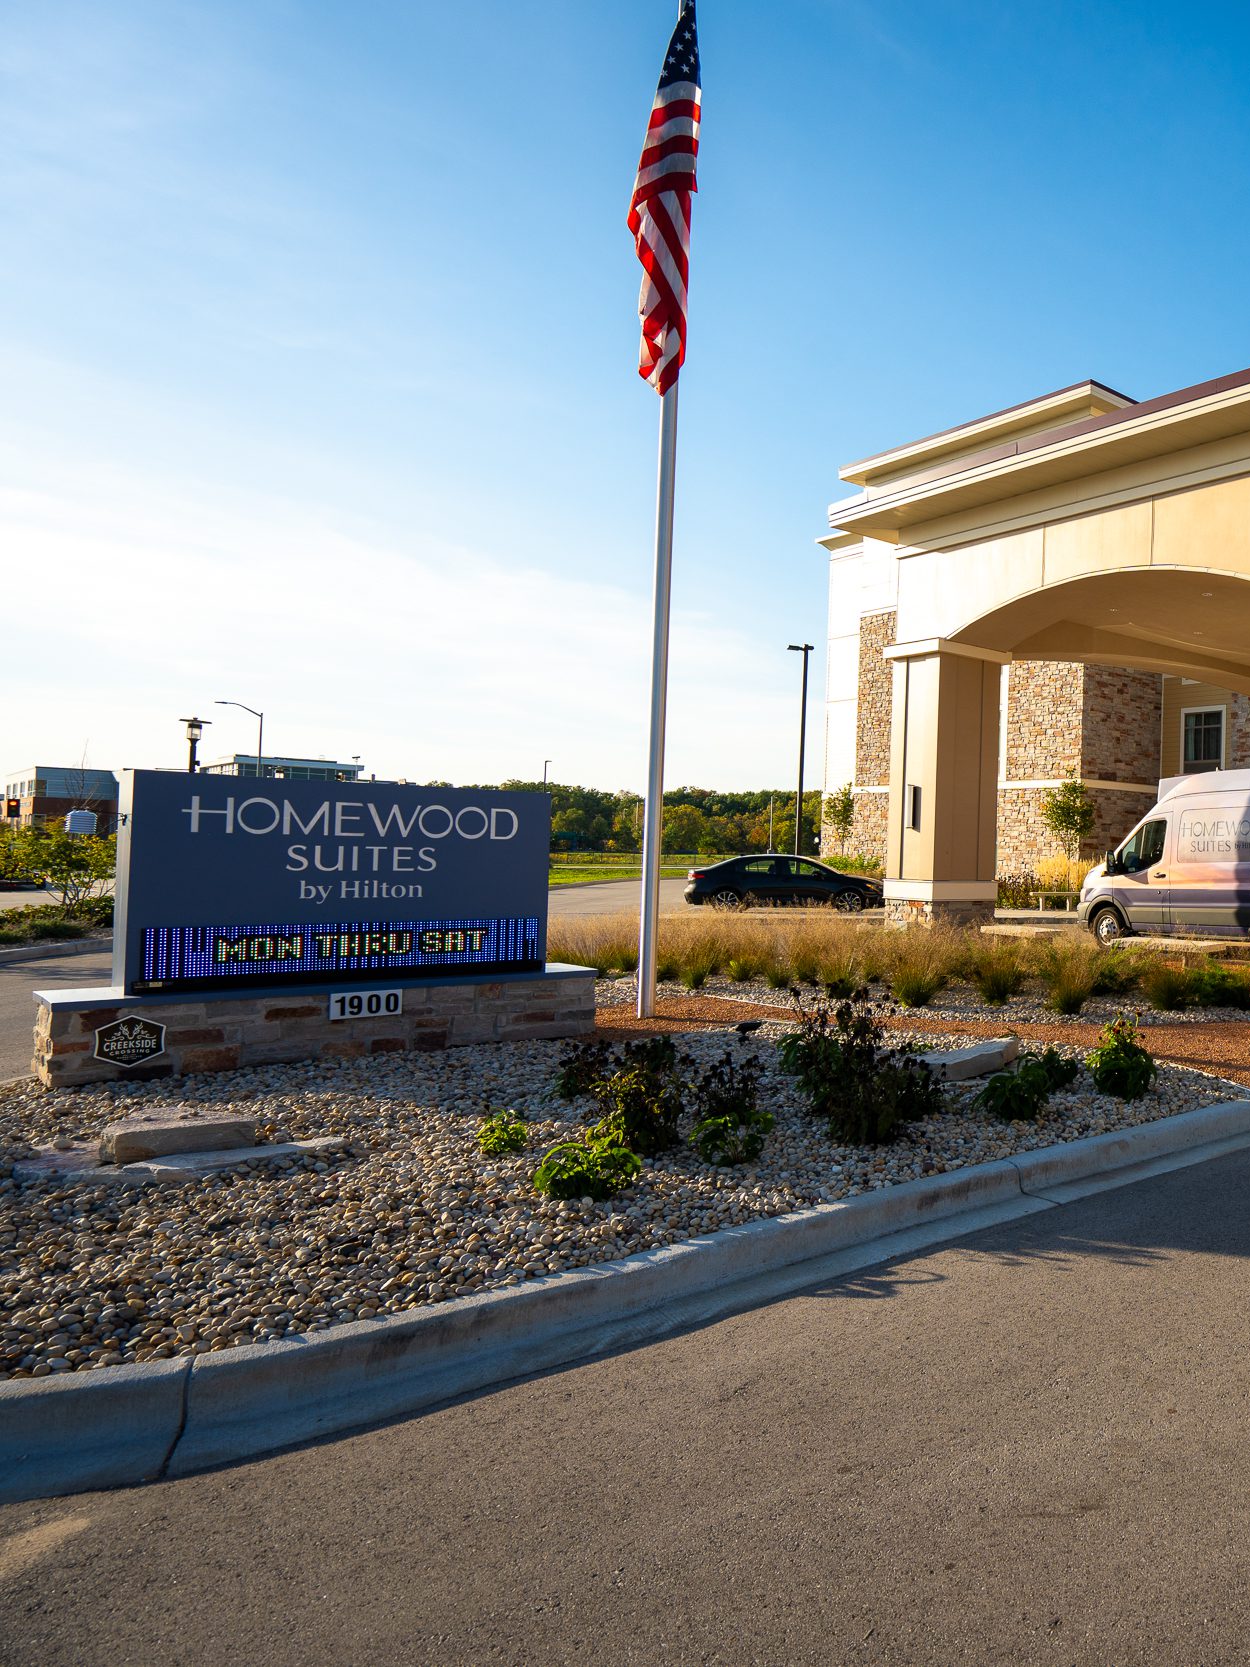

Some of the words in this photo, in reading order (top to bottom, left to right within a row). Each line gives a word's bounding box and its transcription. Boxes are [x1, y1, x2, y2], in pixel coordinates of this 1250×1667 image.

[181, 795, 519, 840] HOMEWOOD
[286, 844, 437, 872] SUITES
[1190, 840, 1231, 853] SUITES
[300, 880, 333, 905] by
[340, 880, 424, 899] Hilton
[217, 935, 301, 962] MON
[315, 932, 410, 958] THRU
[422, 929, 487, 953] SAT
[334, 992, 400, 1017] 1900
[103, 1039, 157, 1052] CREEKSIDE
[109, 1048, 150, 1056] CROSSING
